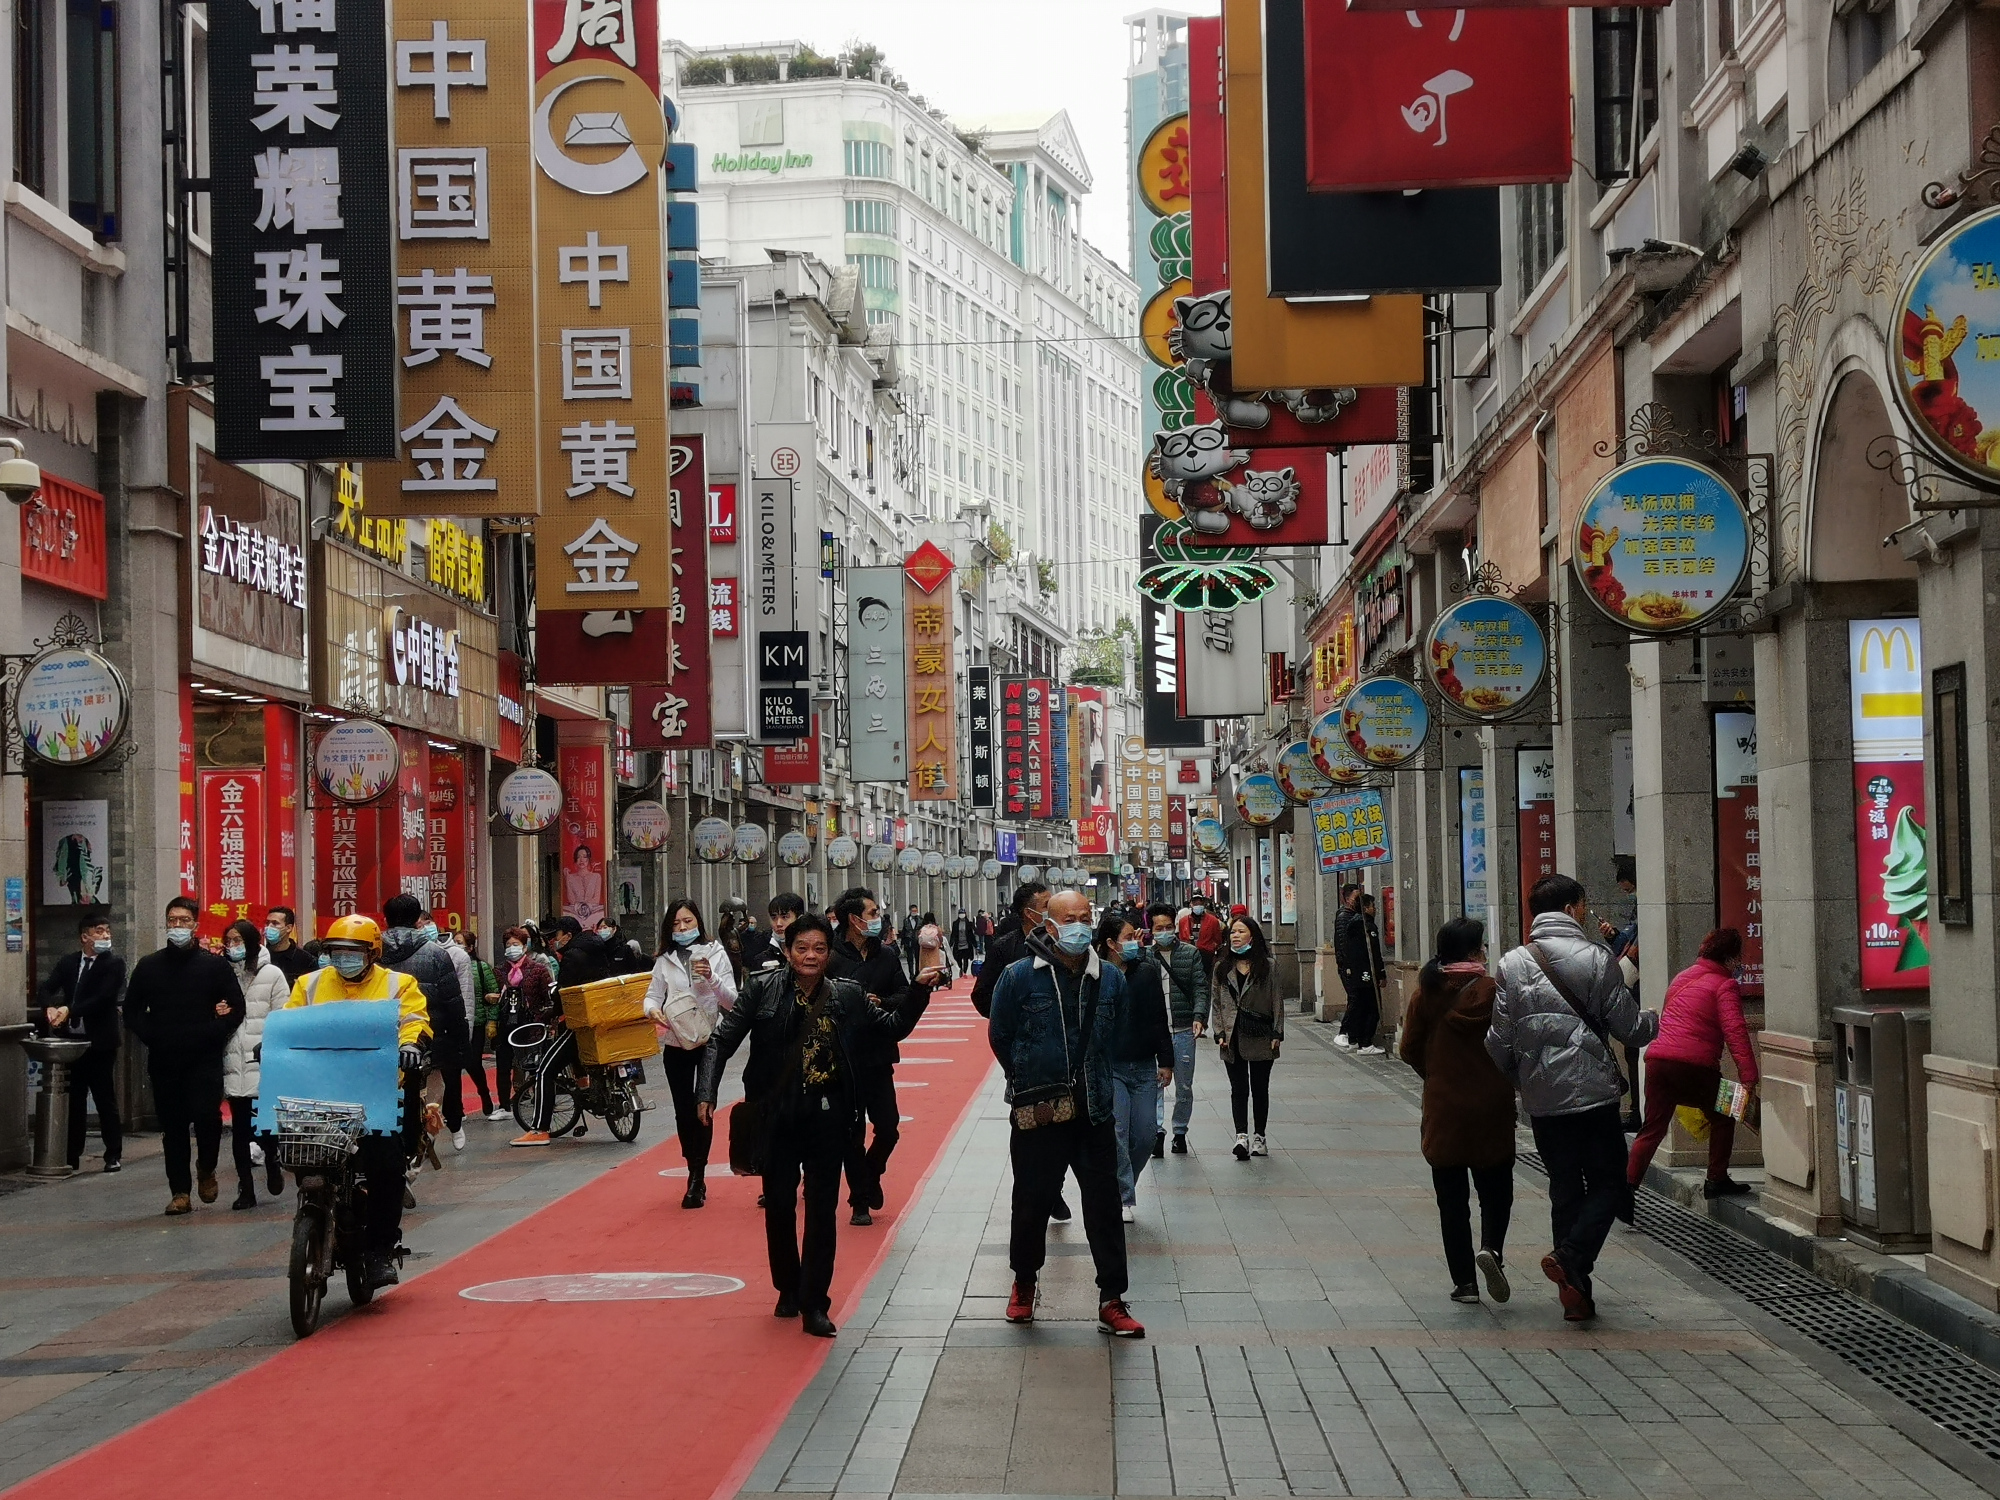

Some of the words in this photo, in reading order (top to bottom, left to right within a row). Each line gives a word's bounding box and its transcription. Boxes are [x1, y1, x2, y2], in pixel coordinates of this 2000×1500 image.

[712, 151, 783, 173] Holiday
[784, 149, 813, 168] Inn
[396, 20, 498, 491] 中国黄金
[558, 230, 640, 593] 中国黄金
[1623, 492, 1696, 512] 弘扬双拥
[1643, 513, 1716, 533] 光荣传统
[203, 505, 307, 609] 金六福荣耀珠宝
[761, 492, 776, 616] KILO&METERS
[1623, 535, 1696, 555] 加强军政
[1643, 556, 1717, 577] 军民团结
[407, 615, 460, 698] 中国黄金
[765, 645, 803, 667] KM
[765, 696, 793, 706] KILO
[765, 716, 804, 725] METERS
[972, 685, 990, 788] 莱克斯顿
[584, 760, 598, 839] 到周六福
[1126, 765, 1144, 839] 中国黄金
[1147, 768, 1163, 839] 中国黄金
[1315, 811, 1348, 833] 烤肉
[1351, 804, 1384, 827] 火锅
[1868, 794, 1889, 840] 圣诞树
[219, 778, 246, 901] 金六福荣耀
[1321, 825, 1384, 853] 自助餐厅
